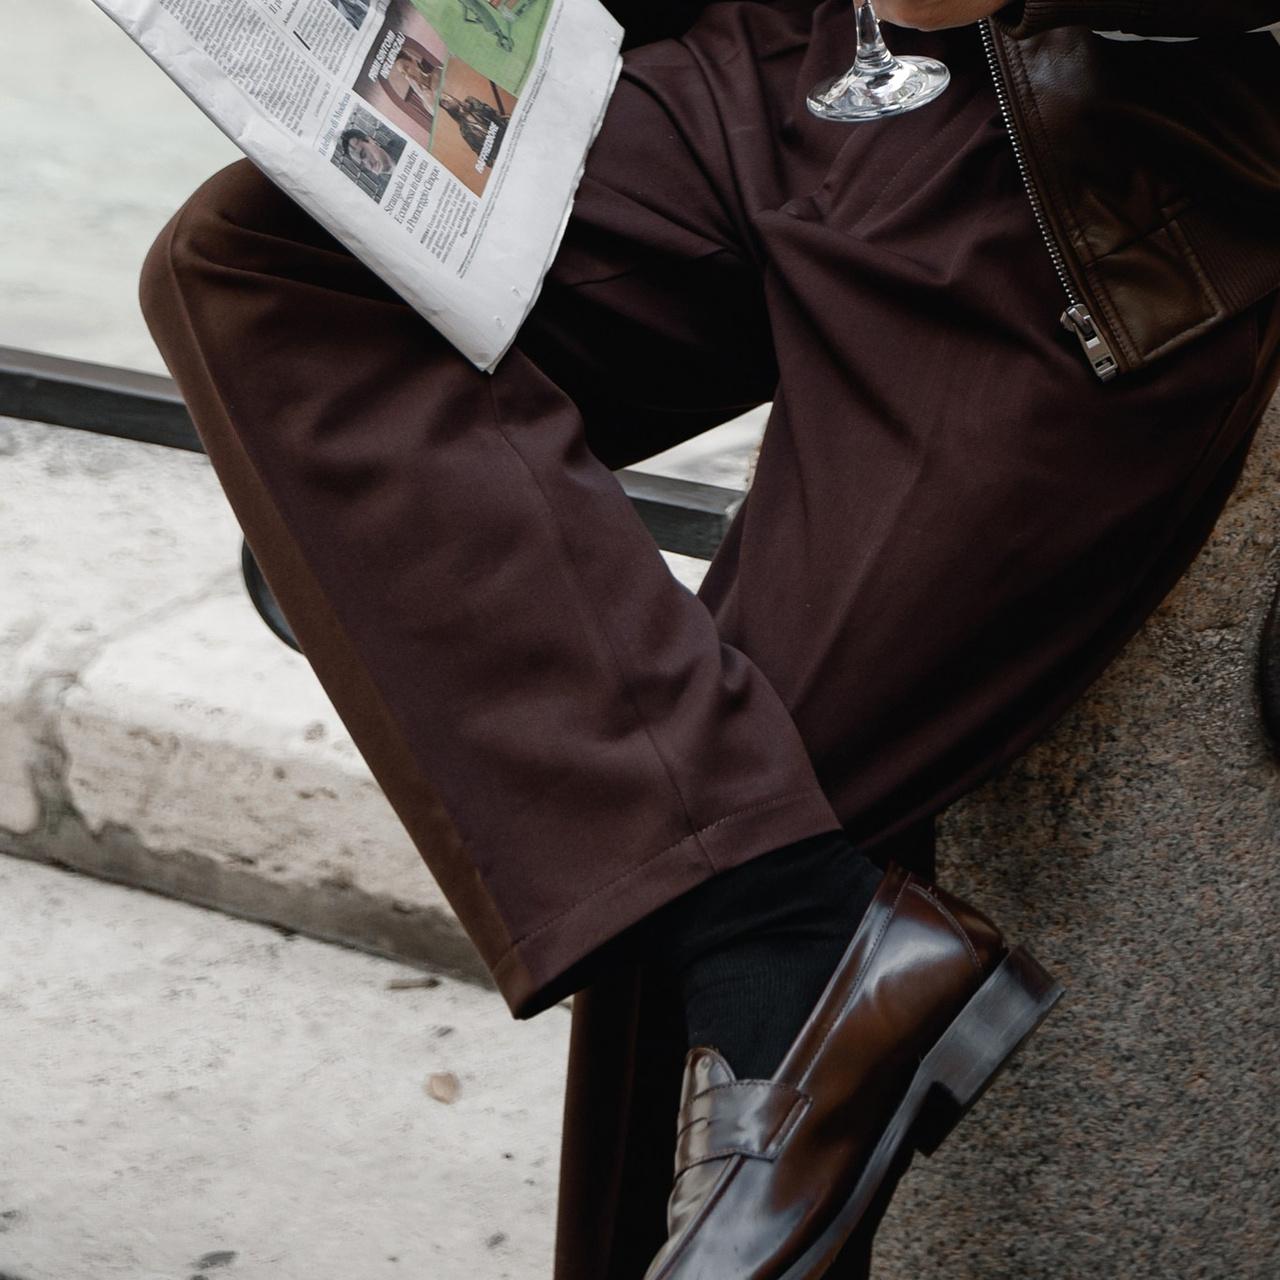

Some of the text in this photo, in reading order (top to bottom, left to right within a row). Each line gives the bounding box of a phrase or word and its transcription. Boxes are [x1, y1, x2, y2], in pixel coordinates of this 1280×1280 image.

[267, 3, 278, 15] Il
[367, 29, 395, 82] PRIMI SINTOMI
[379, 31, 405, 79] INFLUENZALI
[317, 92, 351, 156] Il delitto di Modena
[473, 121, 498, 174] RAFFREDDORE
[383, 149, 418, 217] Strangola la madre
[392, 159, 429, 225] E confessa in diretta
[405, 165, 440, 234] a Pomeriggio Cinque
